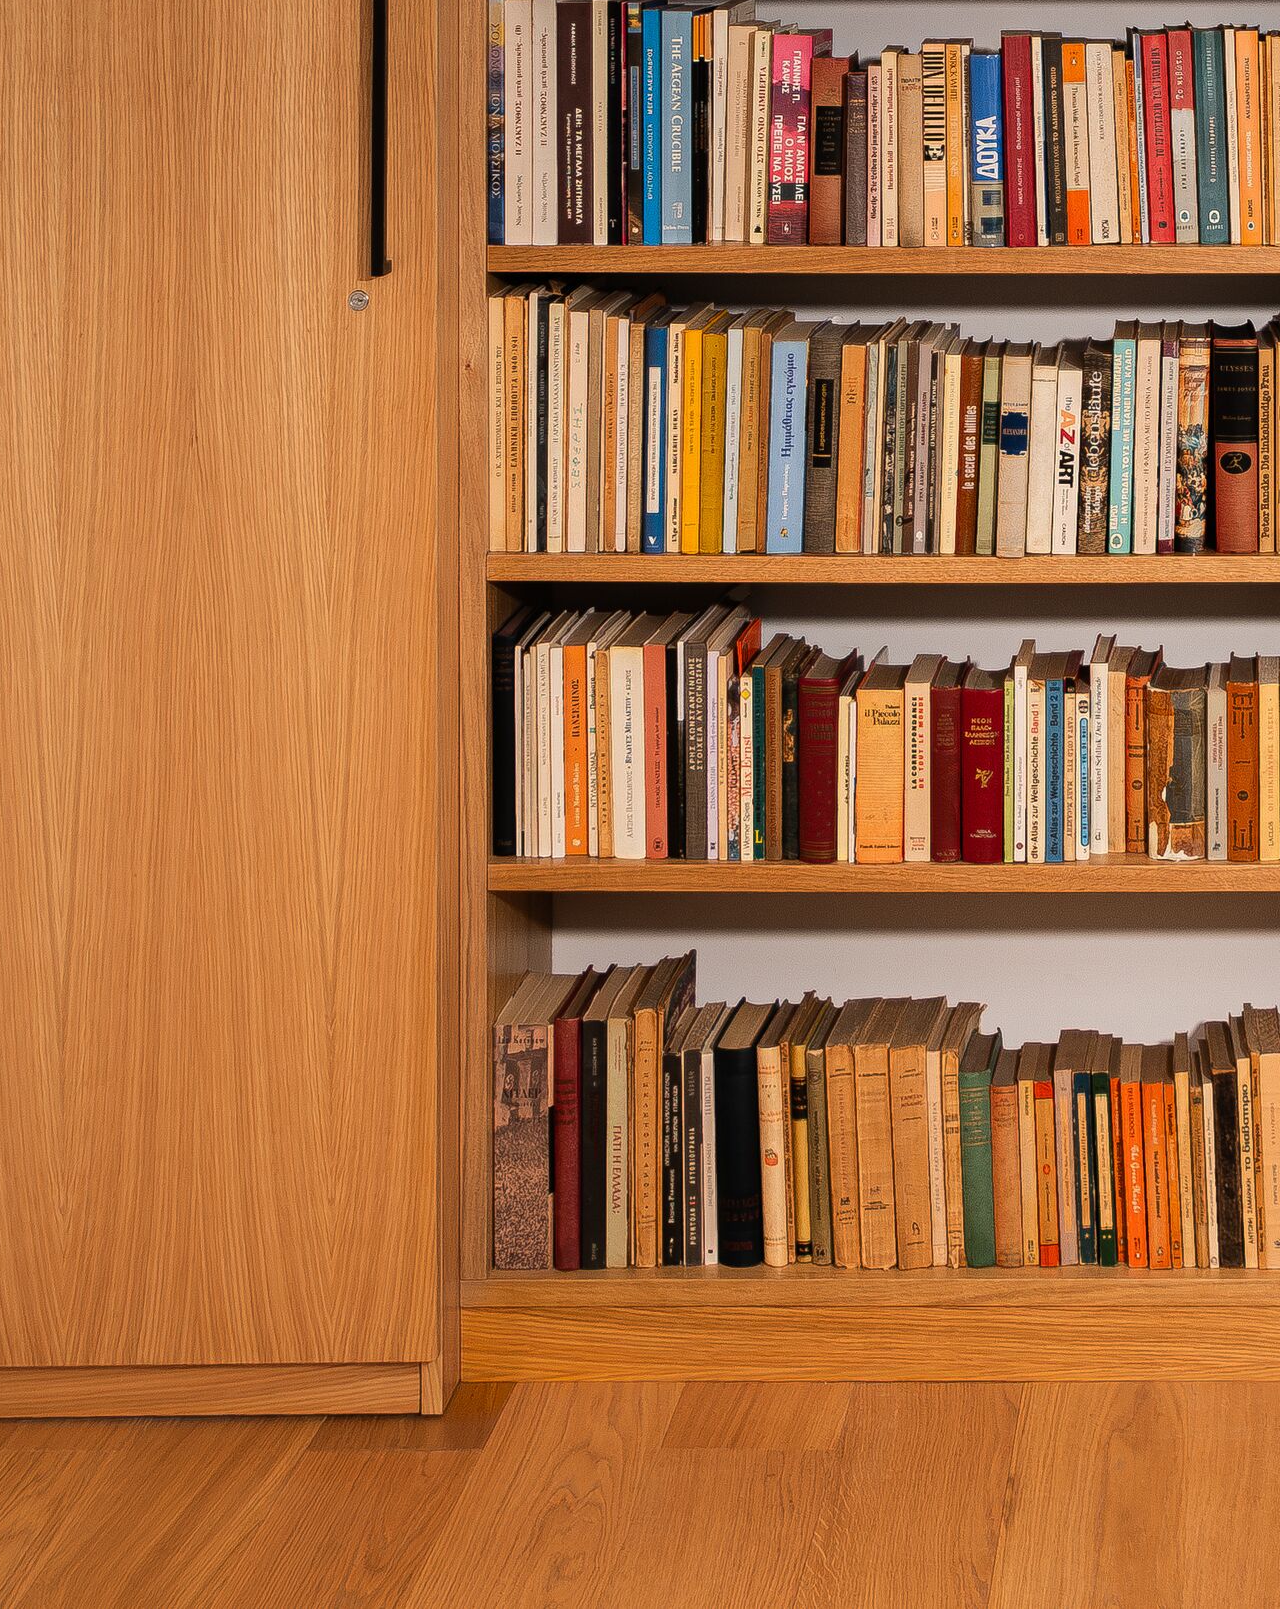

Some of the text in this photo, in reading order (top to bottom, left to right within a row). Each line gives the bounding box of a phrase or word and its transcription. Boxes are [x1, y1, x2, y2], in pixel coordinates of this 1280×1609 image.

[671, 36, 683, 172] THE AEGEAN CRUCIBLE
[782, 60, 791, 93] ΚΑΨΗΣ
[791, 50, 801, 103] ΓΙΑΝΝΗΣ Π.
[923, 51, 944, 141] DON DELILLO
[772, 115, 783, 205] ΠΡΕΠΕΙ ΝΑ ΔΥΣΕΙ
[976, 116, 998, 180] ΔΟΥΚΑ
[781, 353, 797, 458] Ημιμάθειας εγκώμιο
[962, 406, 976, 490] le secret des hittites
[1086, 372, 1103, 472] lebensläufe
[1261, 366, 1272, 539] Peter Handke Die linkshändige Frau
[912, 780, 917, 790] LA
[612, 1125, 622, 1213] ΓΙΑΤΙ Η ΕΛΛΑΔΑ;
